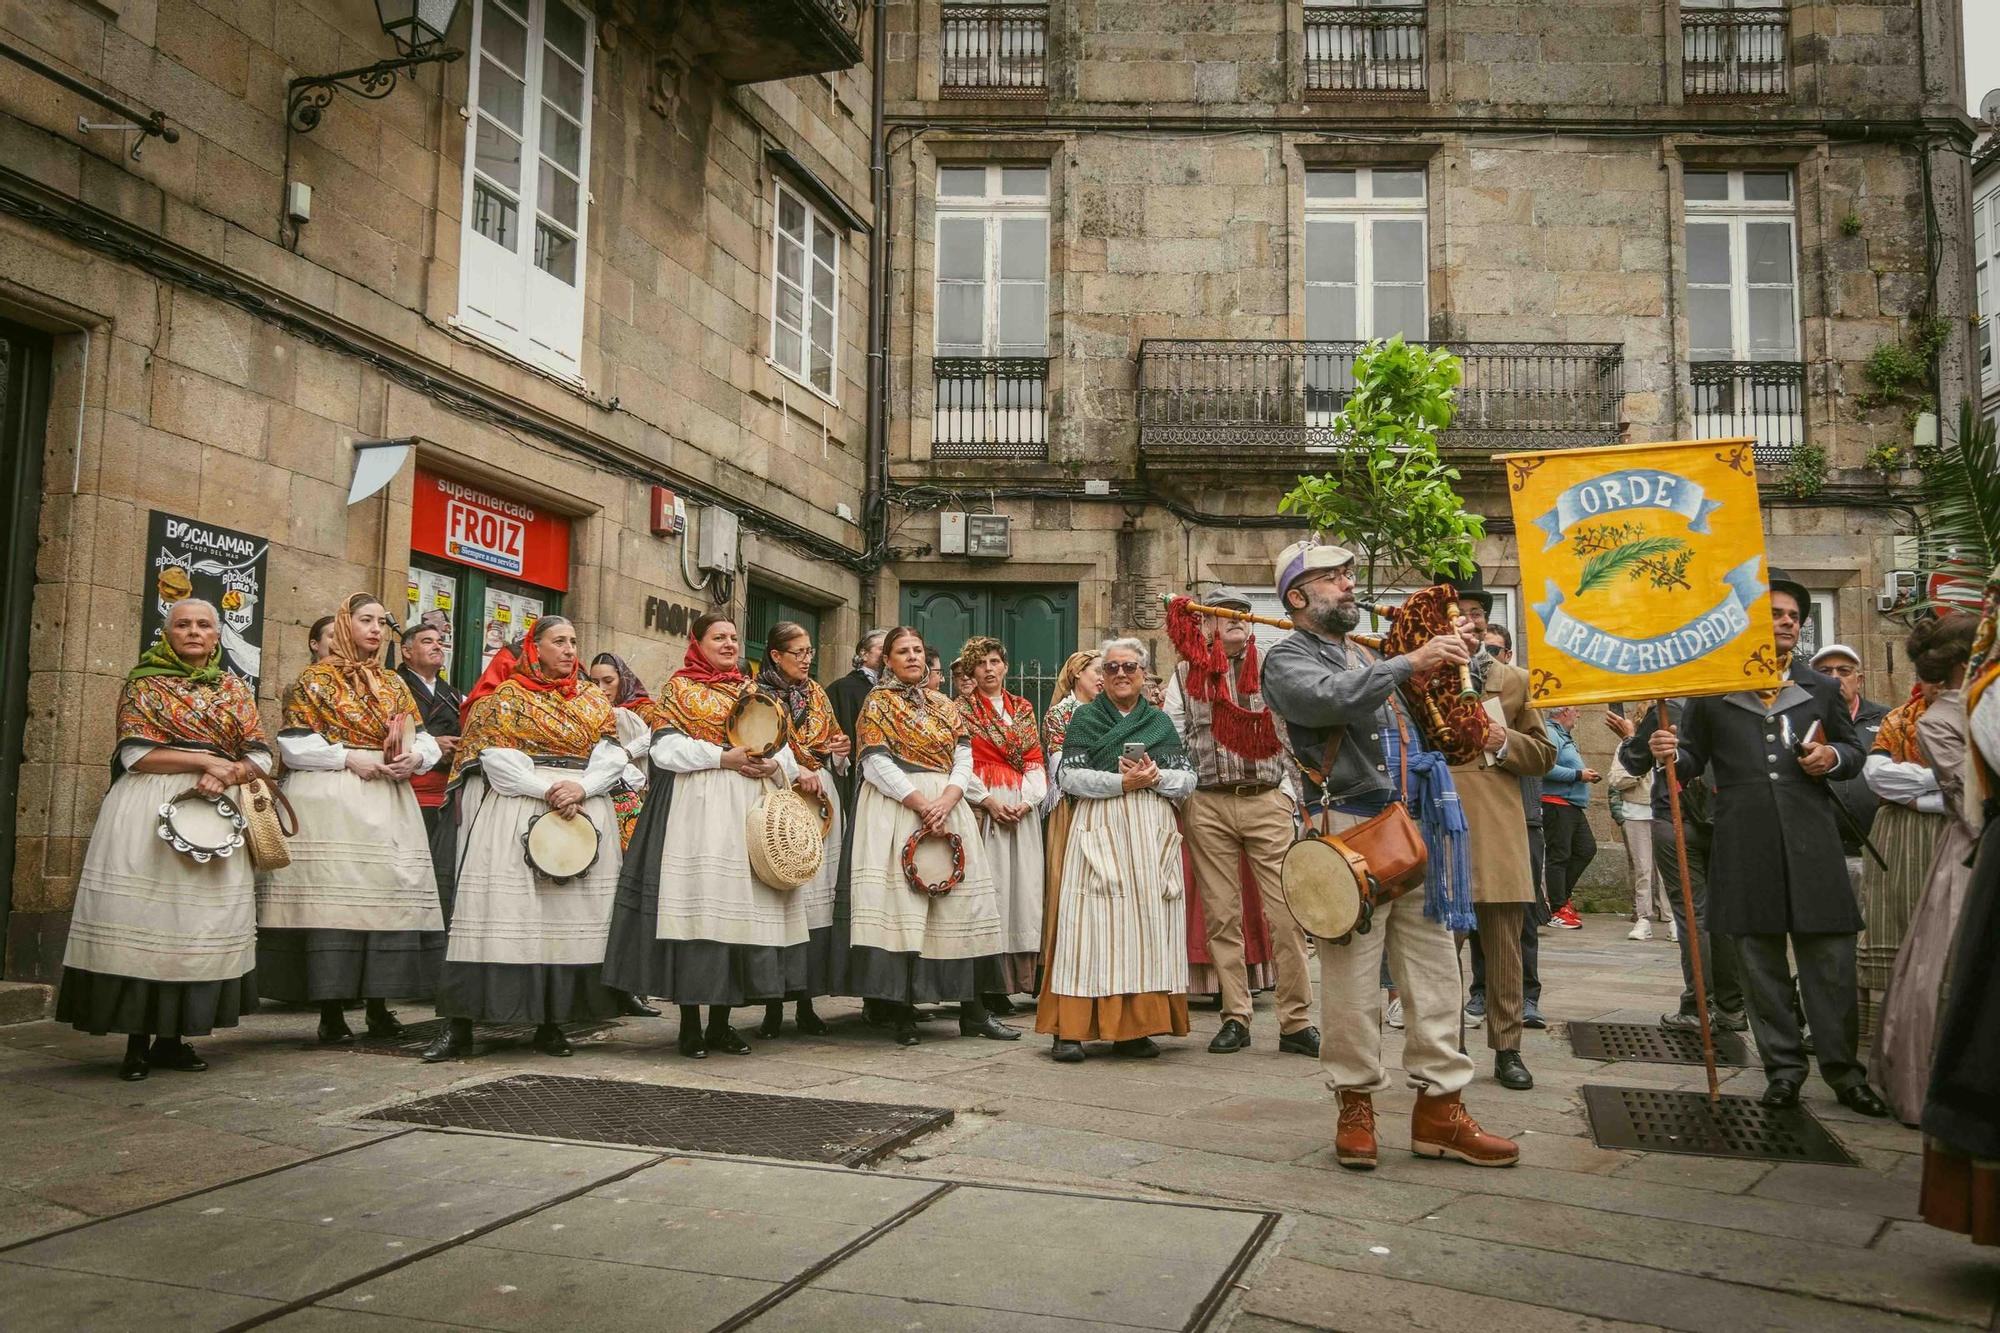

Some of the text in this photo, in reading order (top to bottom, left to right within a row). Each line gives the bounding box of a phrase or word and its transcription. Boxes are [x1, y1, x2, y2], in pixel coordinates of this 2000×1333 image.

[437, 479, 535, 522] supermercado
[1579, 475, 1676, 514] ORDE
[166, 519, 255, 557] BOCALAMAR
[450, 503, 521, 558] FROIZ
[180, 541, 239, 560] BOCADO DEL MAR
